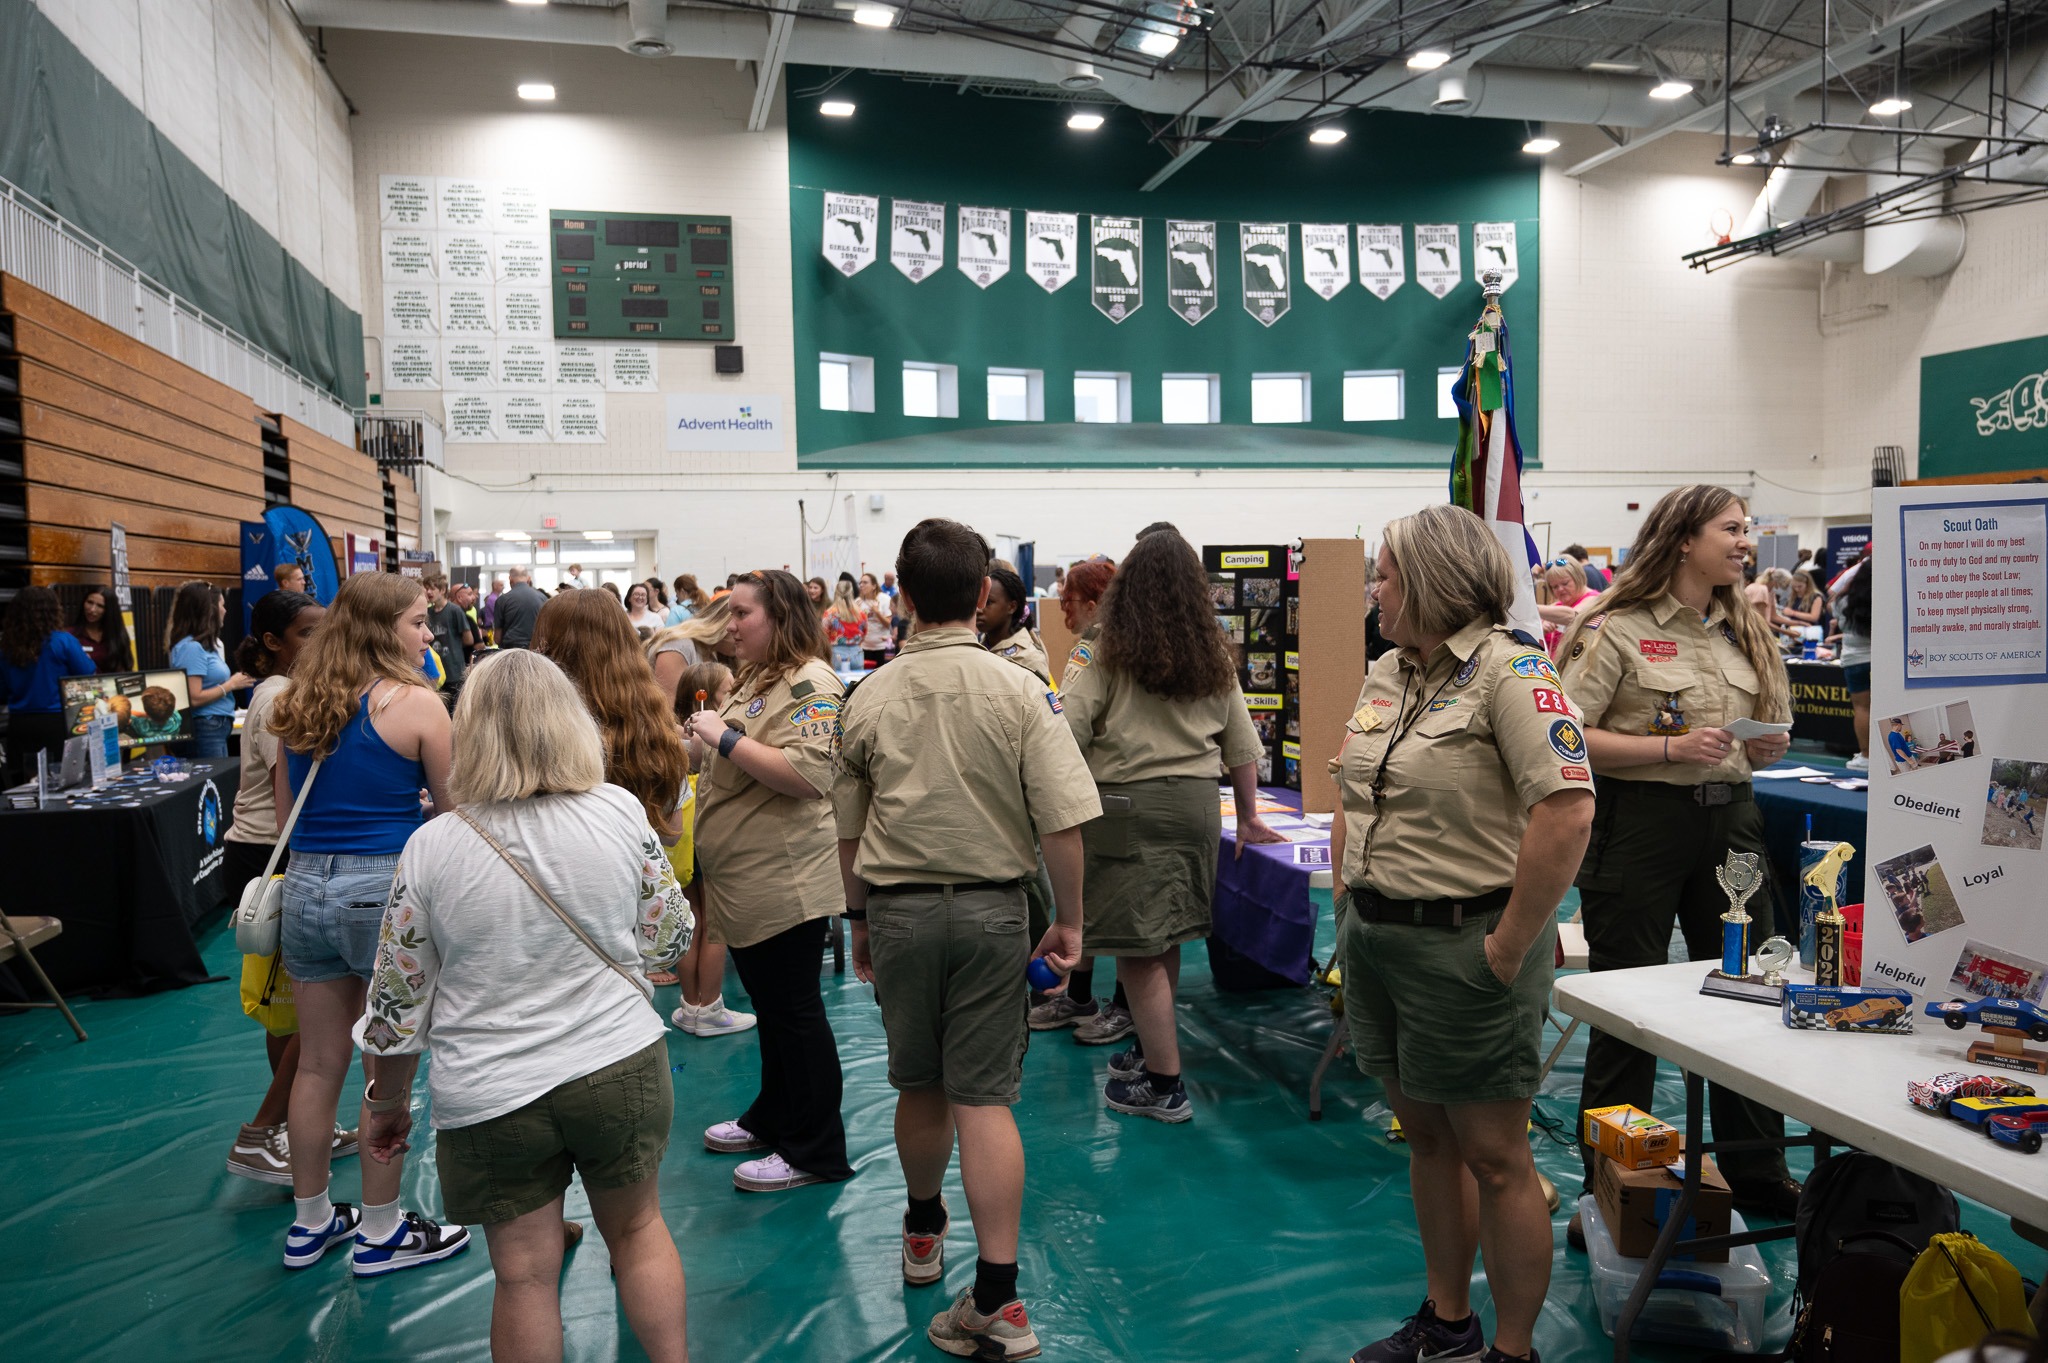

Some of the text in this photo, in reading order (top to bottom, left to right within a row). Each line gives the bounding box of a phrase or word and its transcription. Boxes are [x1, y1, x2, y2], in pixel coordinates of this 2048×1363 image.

[835, 197, 867, 205] STATE
[895, 203, 928, 211] BUNNELL
[827, 203, 875, 223] RUNNER-UP
[970, 210, 1001, 218] STATE
[563, 220, 585, 230] Home
[696, 225, 722, 234] Guests
[894, 215, 942, 234] FINAL FOUR
[961, 216, 1007, 237] FINAL FOUR
[1029, 222, 1074, 239] RUNNER-UP
[1101, 220, 1132, 228] STATE
[1176, 223, 1206, 231] STATE
[1250, 226, 1279, 234] STATE
[1094, 227, 1139, 247] CHAMPIONS
[1169, 230, 1214, 250] CHAMPIONS
[1243, 233, 1286, 252] CHAMPIONS
[1305, 234, 1346, 248] RUNNER-UP
[1360, 234, 1400, 249] FINAL FOUR
[1417, 234, 1457, 249] FINAL FOUR
[1476, 233, 1513, 247] RUNNER-UP
[829, 244, 850, 252] GIRLS
[907, 253, 941, 261] BASKETBALL
[623, 260, 648, 270] period
[1095, 287, 1139, 295] WRESTLING
[1246, 291, 1286, 299] WRESTLING
[571, 322, 586, 330] won
[1943, 517, 1998, 532] Scout Oath
[1842, 534, 1868, 543] VISION
[1919, 537, 2025, 551] On my honor I will do my best
[1225, 555, 1264, 565] Camping
[1908, 553, 2039, 568] To do my duty to God and my country
[1926, 571, 2021, 584] and to obey the Scout Law;
[1917, 587, 2033, 601] To help other people at all times;
[1917, 603, 2032, 617] To keep myself physically strong,
[1910, 619, 2041, 634] mentally awake, and morally straight.
[1653, 641, 1677, 650] LINDA
[1286, 655, 1299, 664] Explo
[1929, 651, 2040, 662] BOY SCOUTS OF AMERICA
[1791, 683, 1851, 702] UNNEL
[1254, 697, 1278, 706] Skills
[1807, 704, 1855, 717] DEPARTMEN
[800, 720, 837, 739] 428
[1893, 794, 1961, 819] Obedient
[1963, 865, 2004, 887] Loyal
[1874, 961, 1926, 988] Helpful
[1976, 1059, 2006, 1068] PINEWOOD
